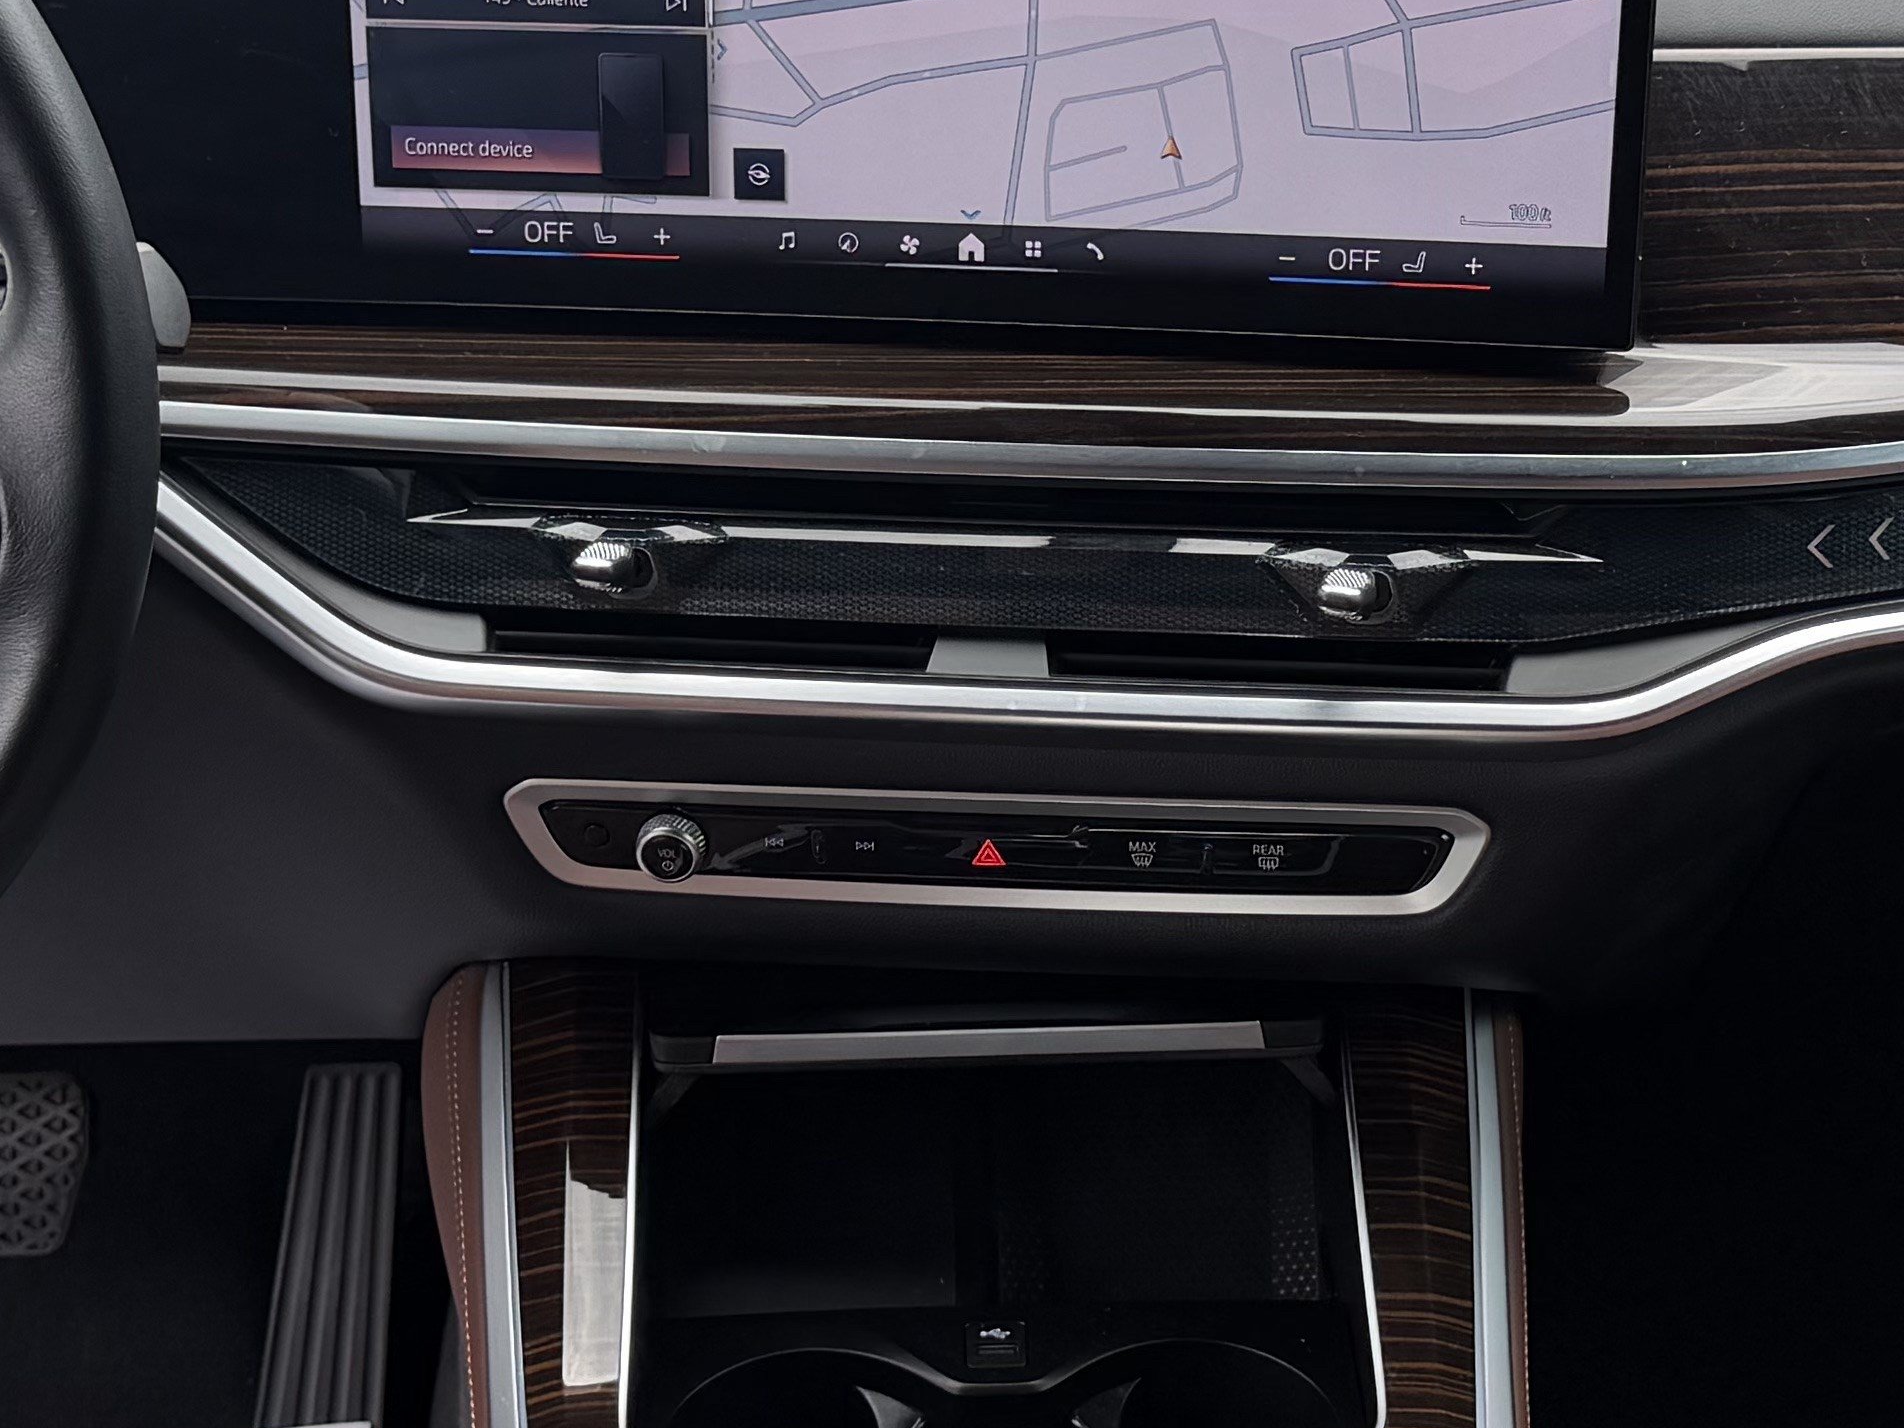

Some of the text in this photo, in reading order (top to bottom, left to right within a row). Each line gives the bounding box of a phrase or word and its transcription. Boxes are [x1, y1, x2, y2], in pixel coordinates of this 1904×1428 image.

[404, 137, 534, 159] Connect device
[523, 220, 574, 243] OFF
[1327, 247, 1381, 272] OFF
[657, 847, 677, 859] VOL
[1128, 841, 1157, 853] MAX
[1252, 844, 1285, 856] REAR
